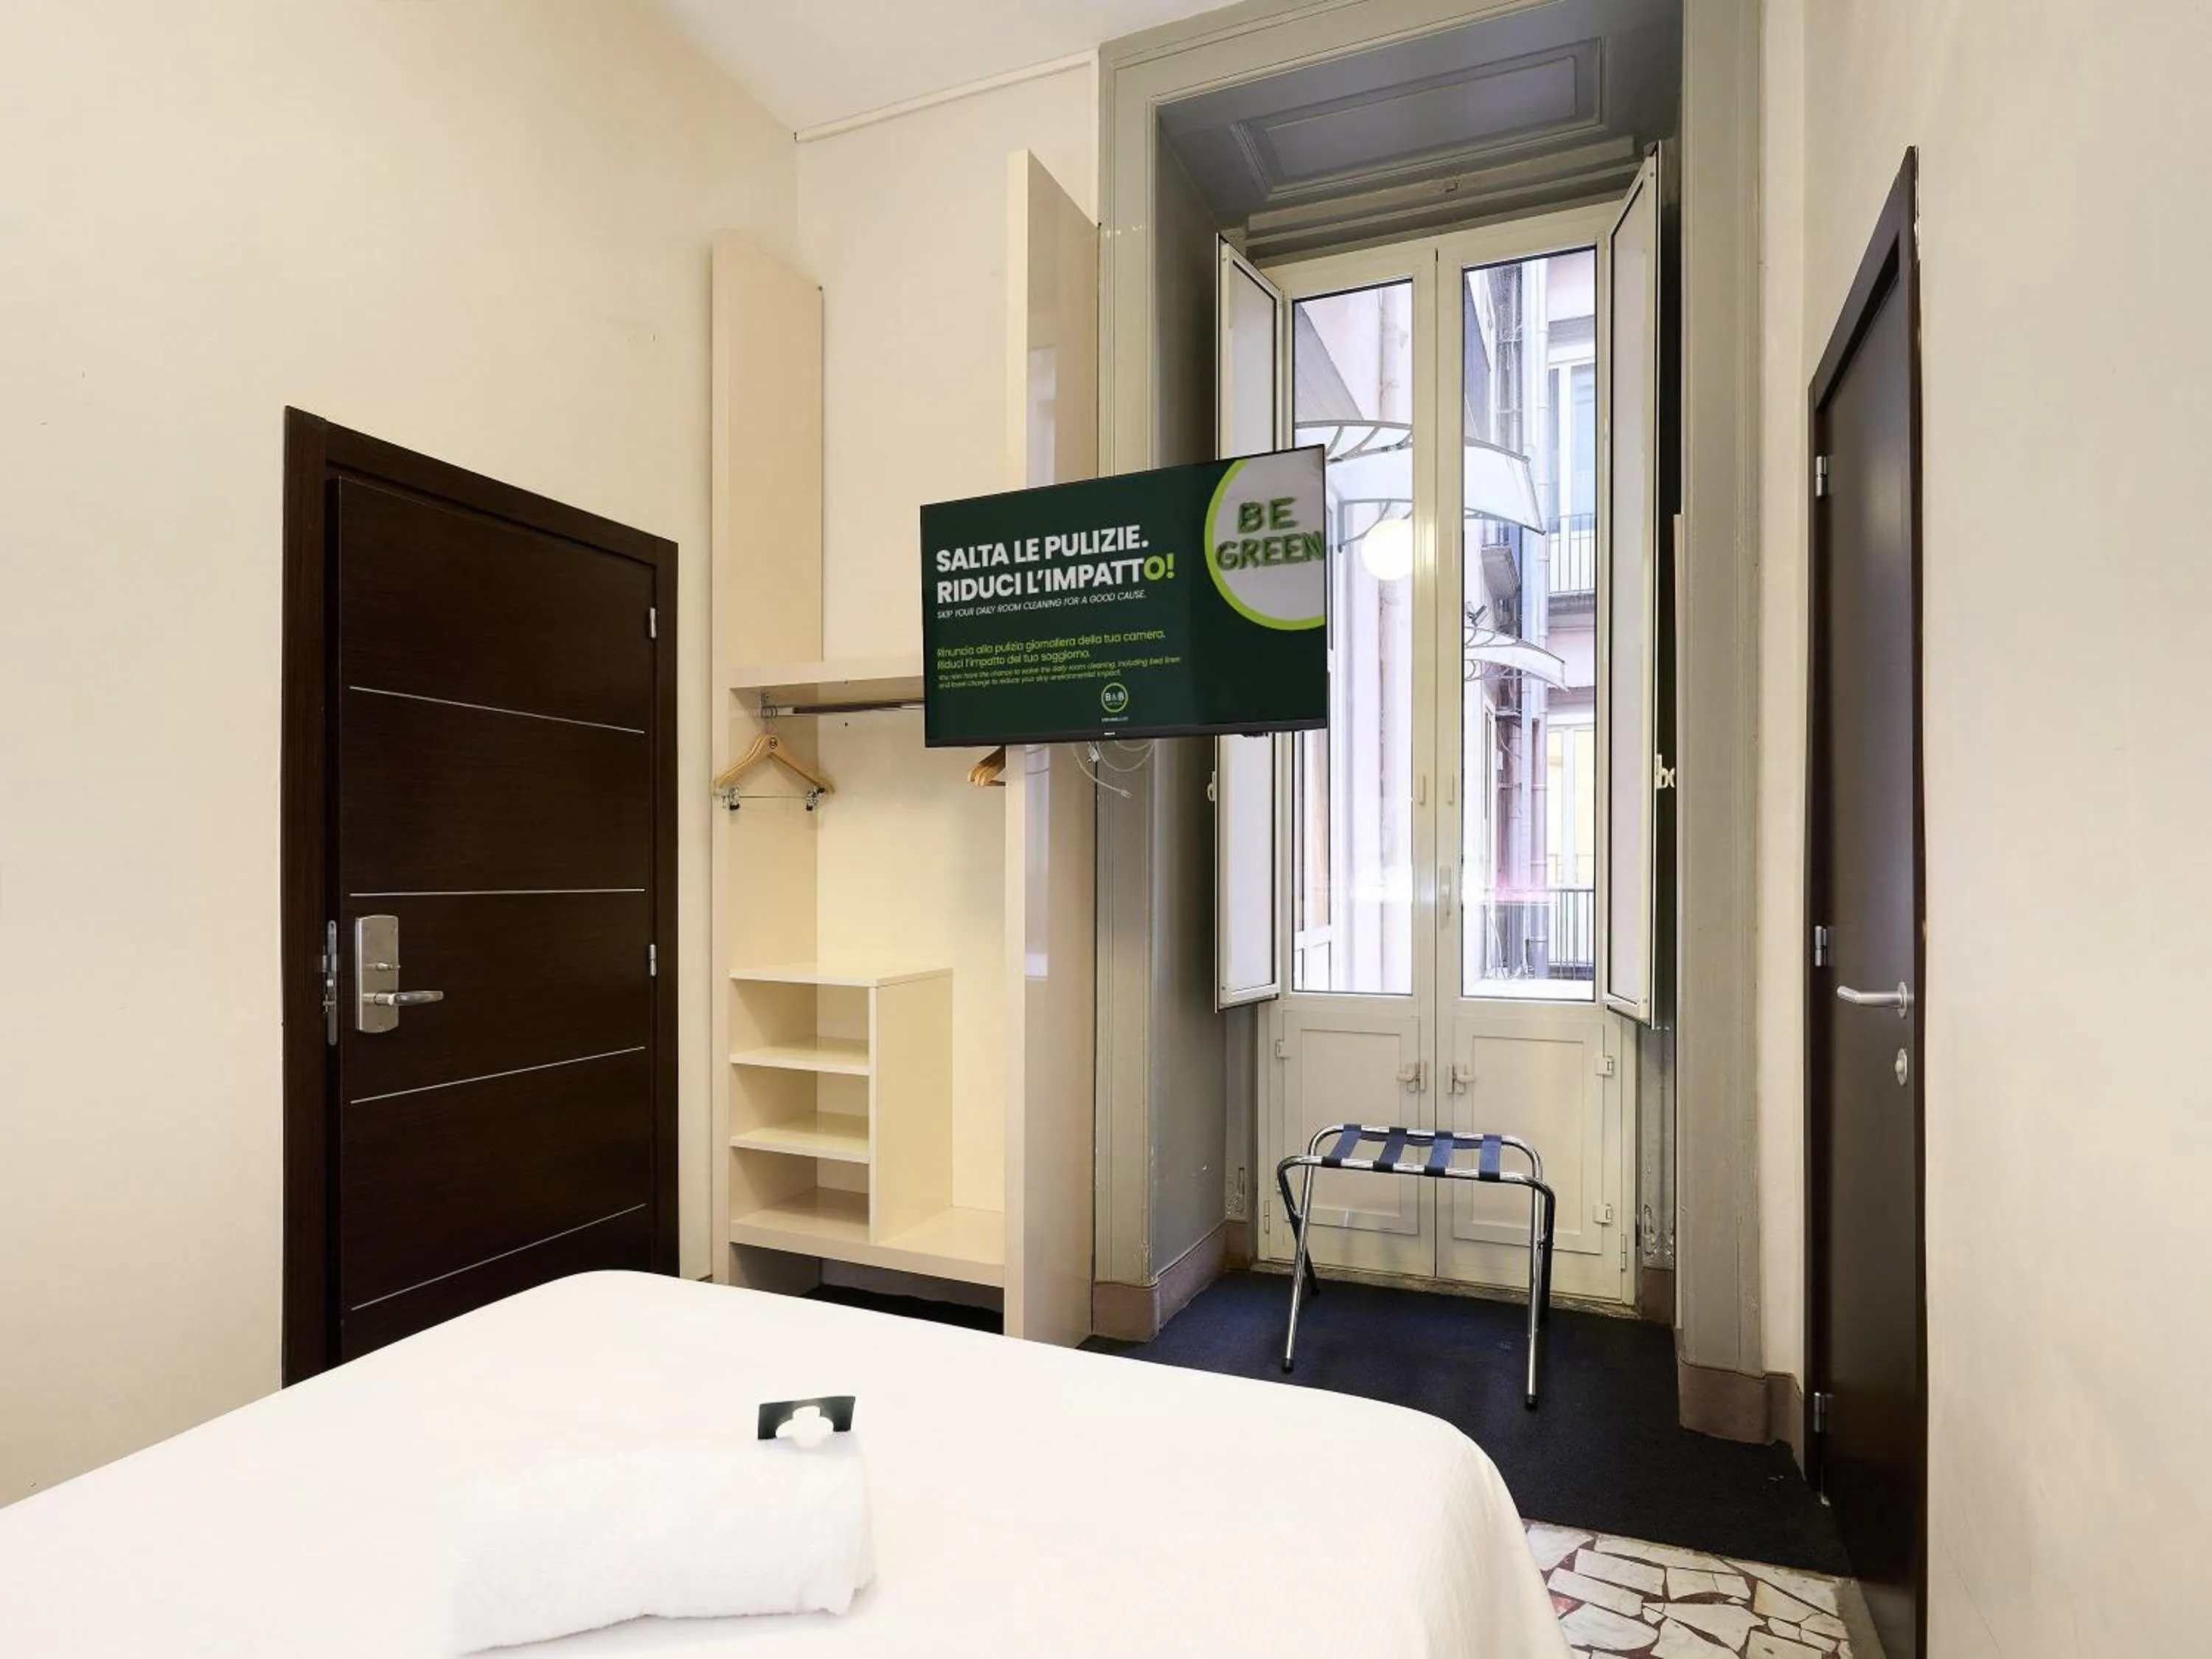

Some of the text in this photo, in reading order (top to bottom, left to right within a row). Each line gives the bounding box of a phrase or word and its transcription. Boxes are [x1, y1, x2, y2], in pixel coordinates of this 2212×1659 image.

[1238, 497, 1300, 534] BE
[936, 524, 1150, 573] SALTA LE PULIZIE.
[1216, 531, 1324, 571] GREEN
[937, 553, 1175, 604] RIDUCI L'IMPATTO!
[937, 610, 953, 619] SKIP
[954, 608, 975, 618] YOUR
[976, 605, 996, 616] DAILY
[997, 602, 1021, 613] ROOM
[1023, 598, 1062, 610] CLEANING
[1063, 597, 1079, 606] FOR
[1090, 592, 1116, 603] GOOD
[1118, 589, 1147, 601] CAUSE.
[937, 658, 964, 670] Riduci
[1007, 654, 1021, 664] del
[1023, 653, 1039, 662] tuo
[1040, 650, 1090, 663] soggiorno.
[975, 644, 993, 654] alla
[995, 641, 1024, 655] pulizia
[1077, 635, 1102, 645] della
[1105, 633, 1121, 644] tua
[1123, 630, 1166, 641] camera.
